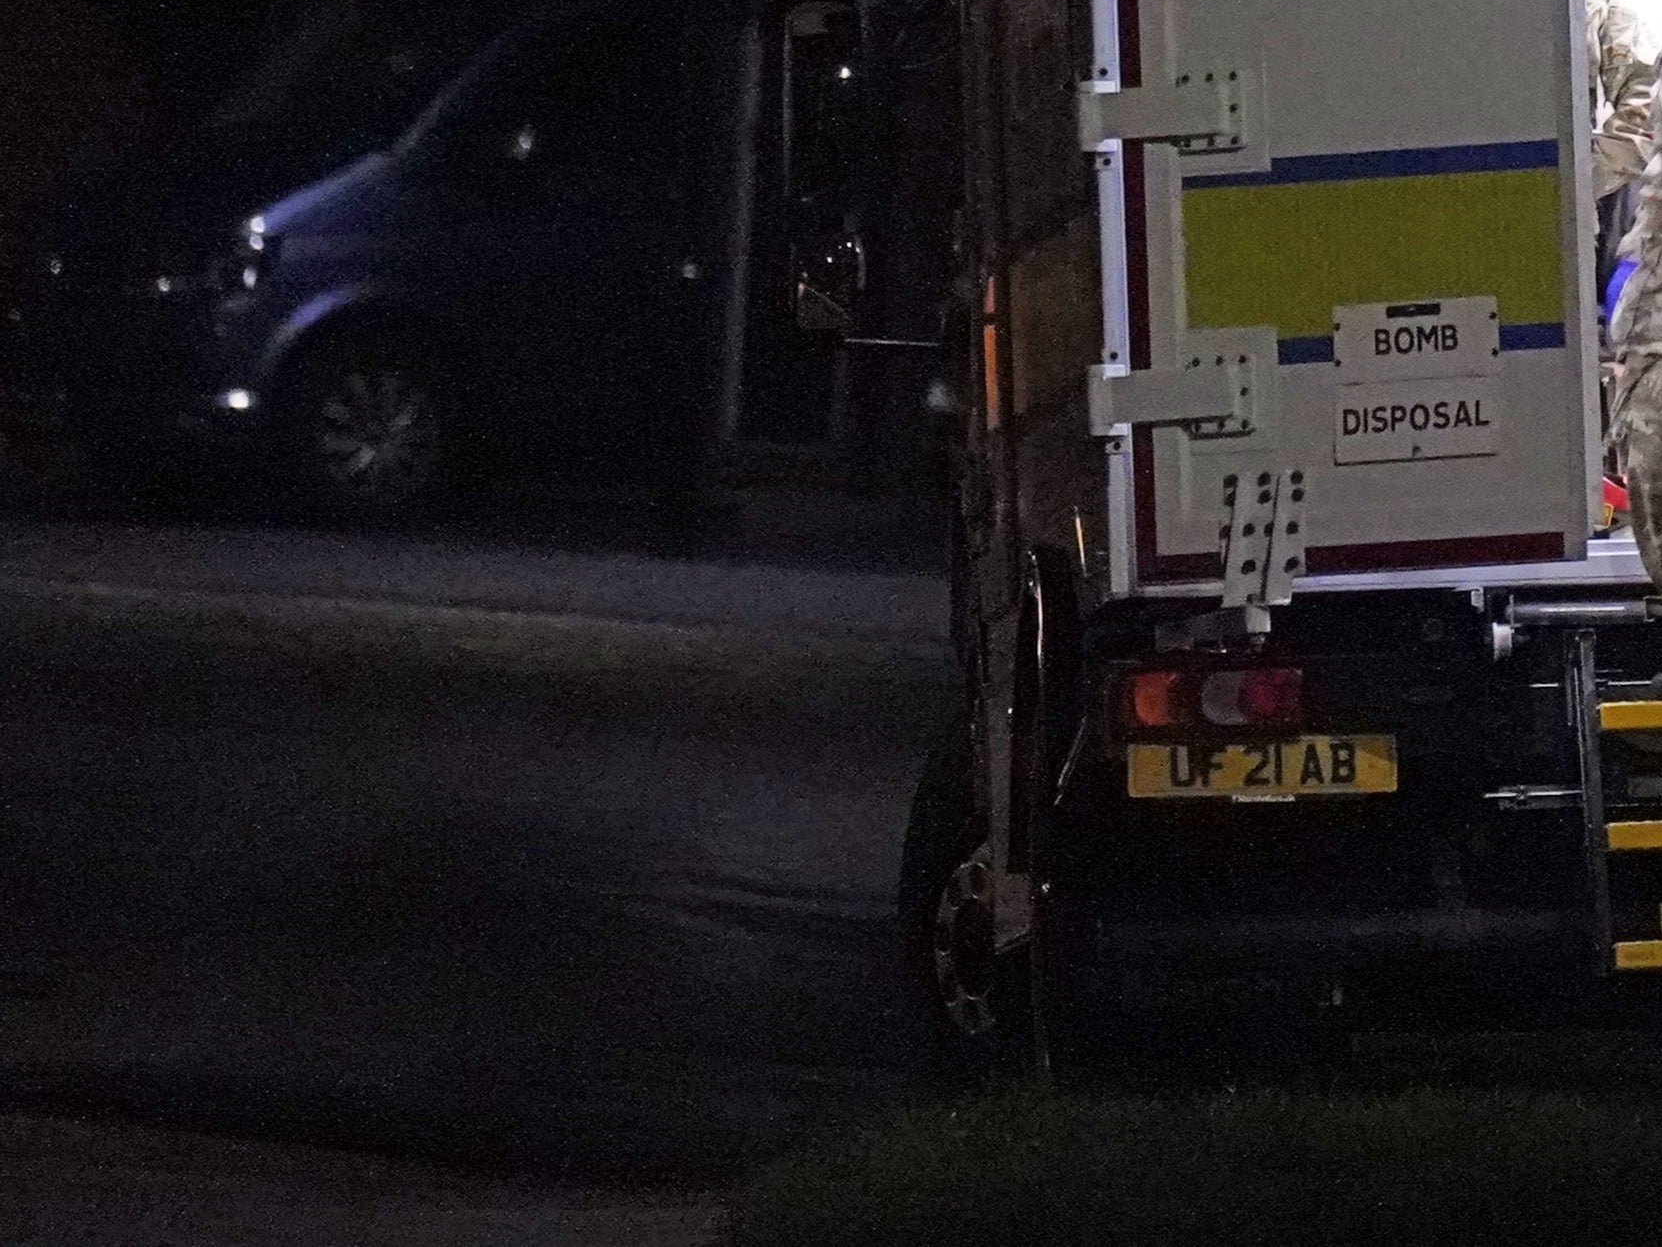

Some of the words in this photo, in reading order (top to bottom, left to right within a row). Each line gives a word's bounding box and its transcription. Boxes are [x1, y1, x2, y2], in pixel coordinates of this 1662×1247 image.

[1374, 324, 1458, 355] BOMB
[1343, 400, 1490, 435] DISPOSAL
[1243, 744, 1283, 786] 21
[1300, 742, 1356, 785] AB
